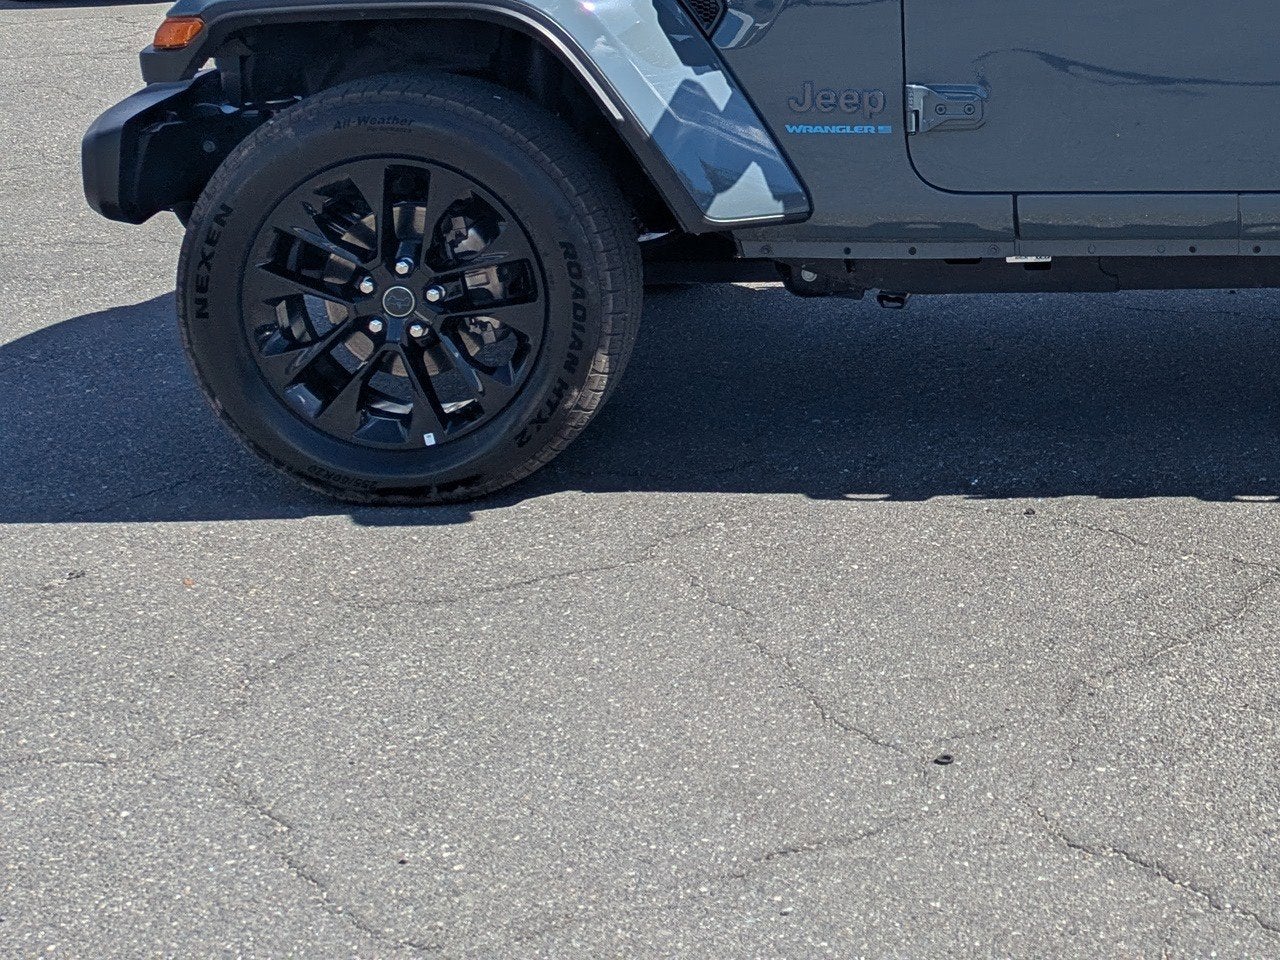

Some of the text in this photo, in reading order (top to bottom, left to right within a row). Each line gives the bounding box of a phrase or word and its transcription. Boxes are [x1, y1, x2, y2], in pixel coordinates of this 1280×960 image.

[784, 124, 876, 134] WRANGLER
[787, 80, 887, 120] Jeep
[194, 203, 234, 319] NEXEN
[558, 240, 587, 374] ROADIAN
